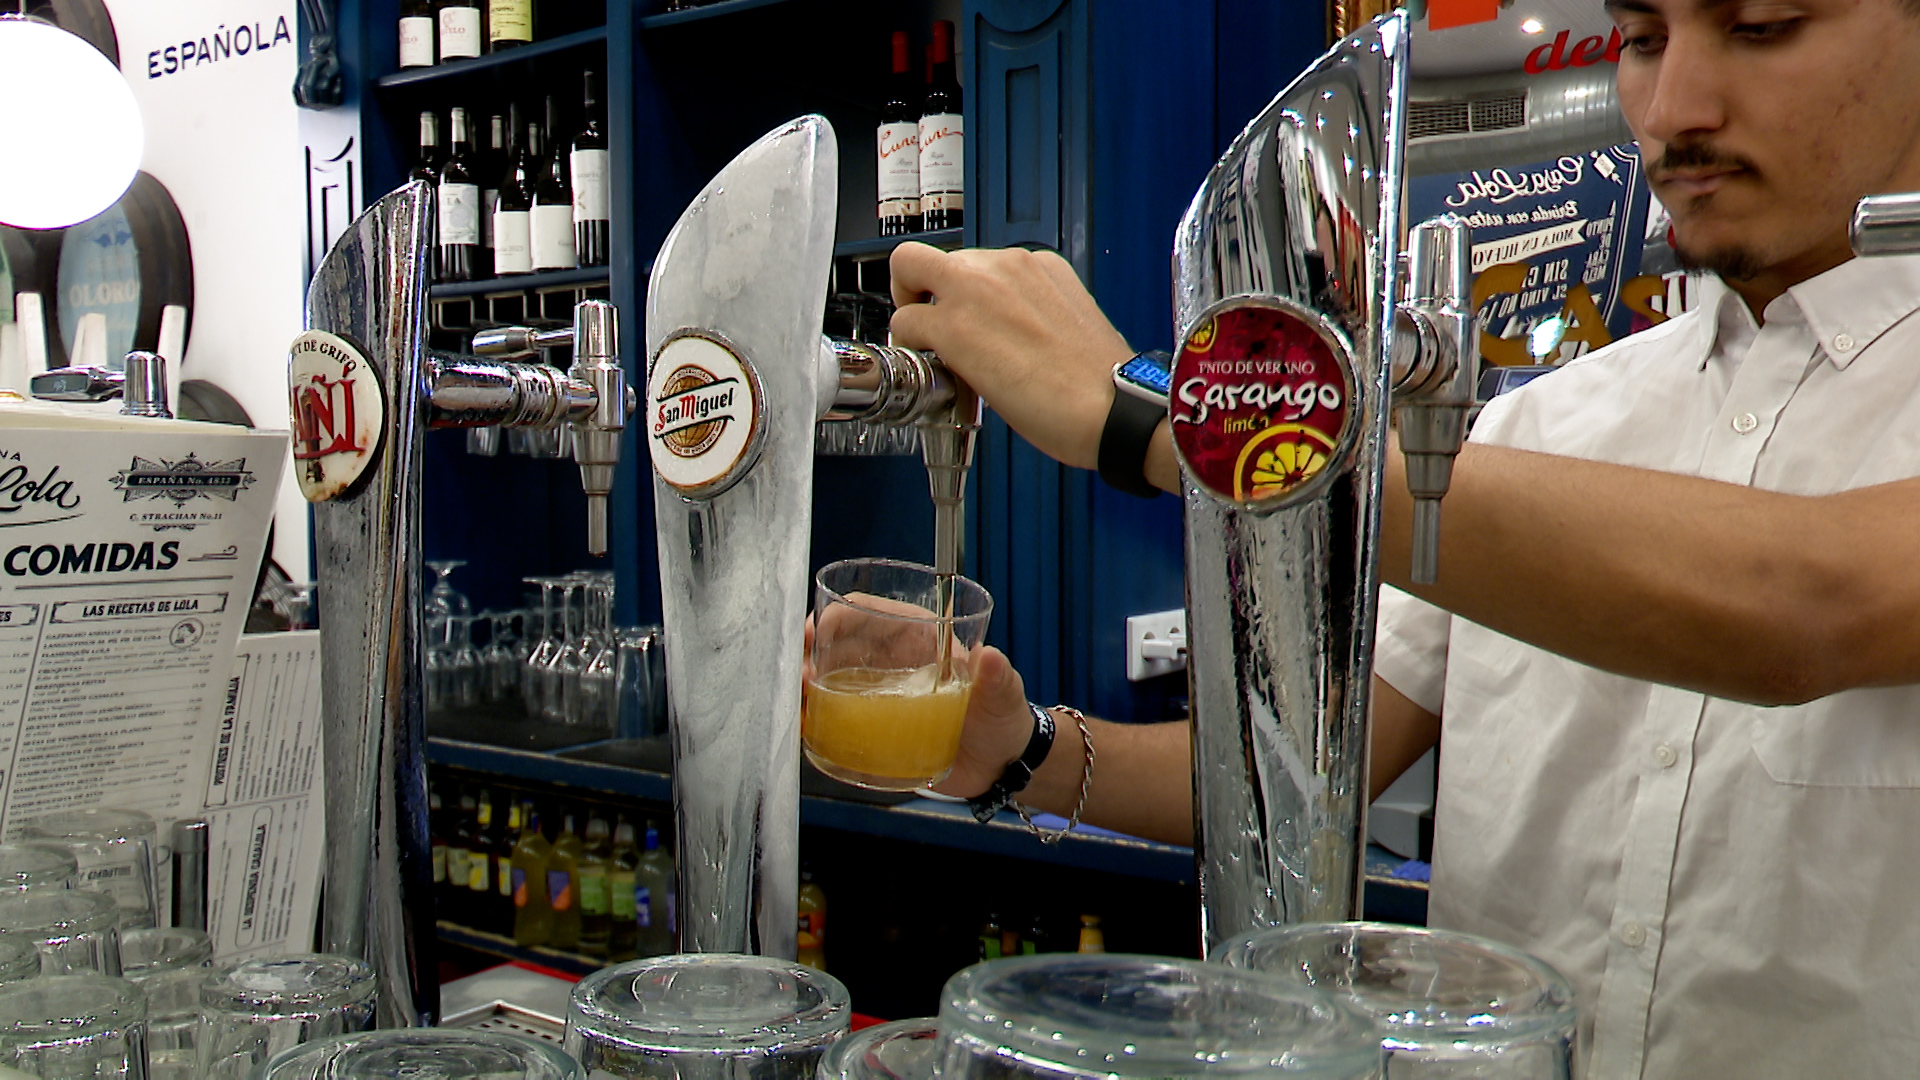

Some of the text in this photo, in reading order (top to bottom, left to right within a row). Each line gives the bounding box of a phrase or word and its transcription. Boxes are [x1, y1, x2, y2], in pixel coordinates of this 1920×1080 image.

[148, 15, 292, 79] ESPAÑOLA
[304, 339, 317, 352] DE
[320, 342, 357, 373] GRIFO
[1236, 361, 1253, 374] DE
[1173, 377, 1341, 424] Sarango
[138, 475, 183, 485] ESPAÑA
[142, 512, 198, 521] STRACHAN
[4, 541, 180, 576] COMIDAS
[82, 599, 199, 618] LAS RECETAS DE LOLA
